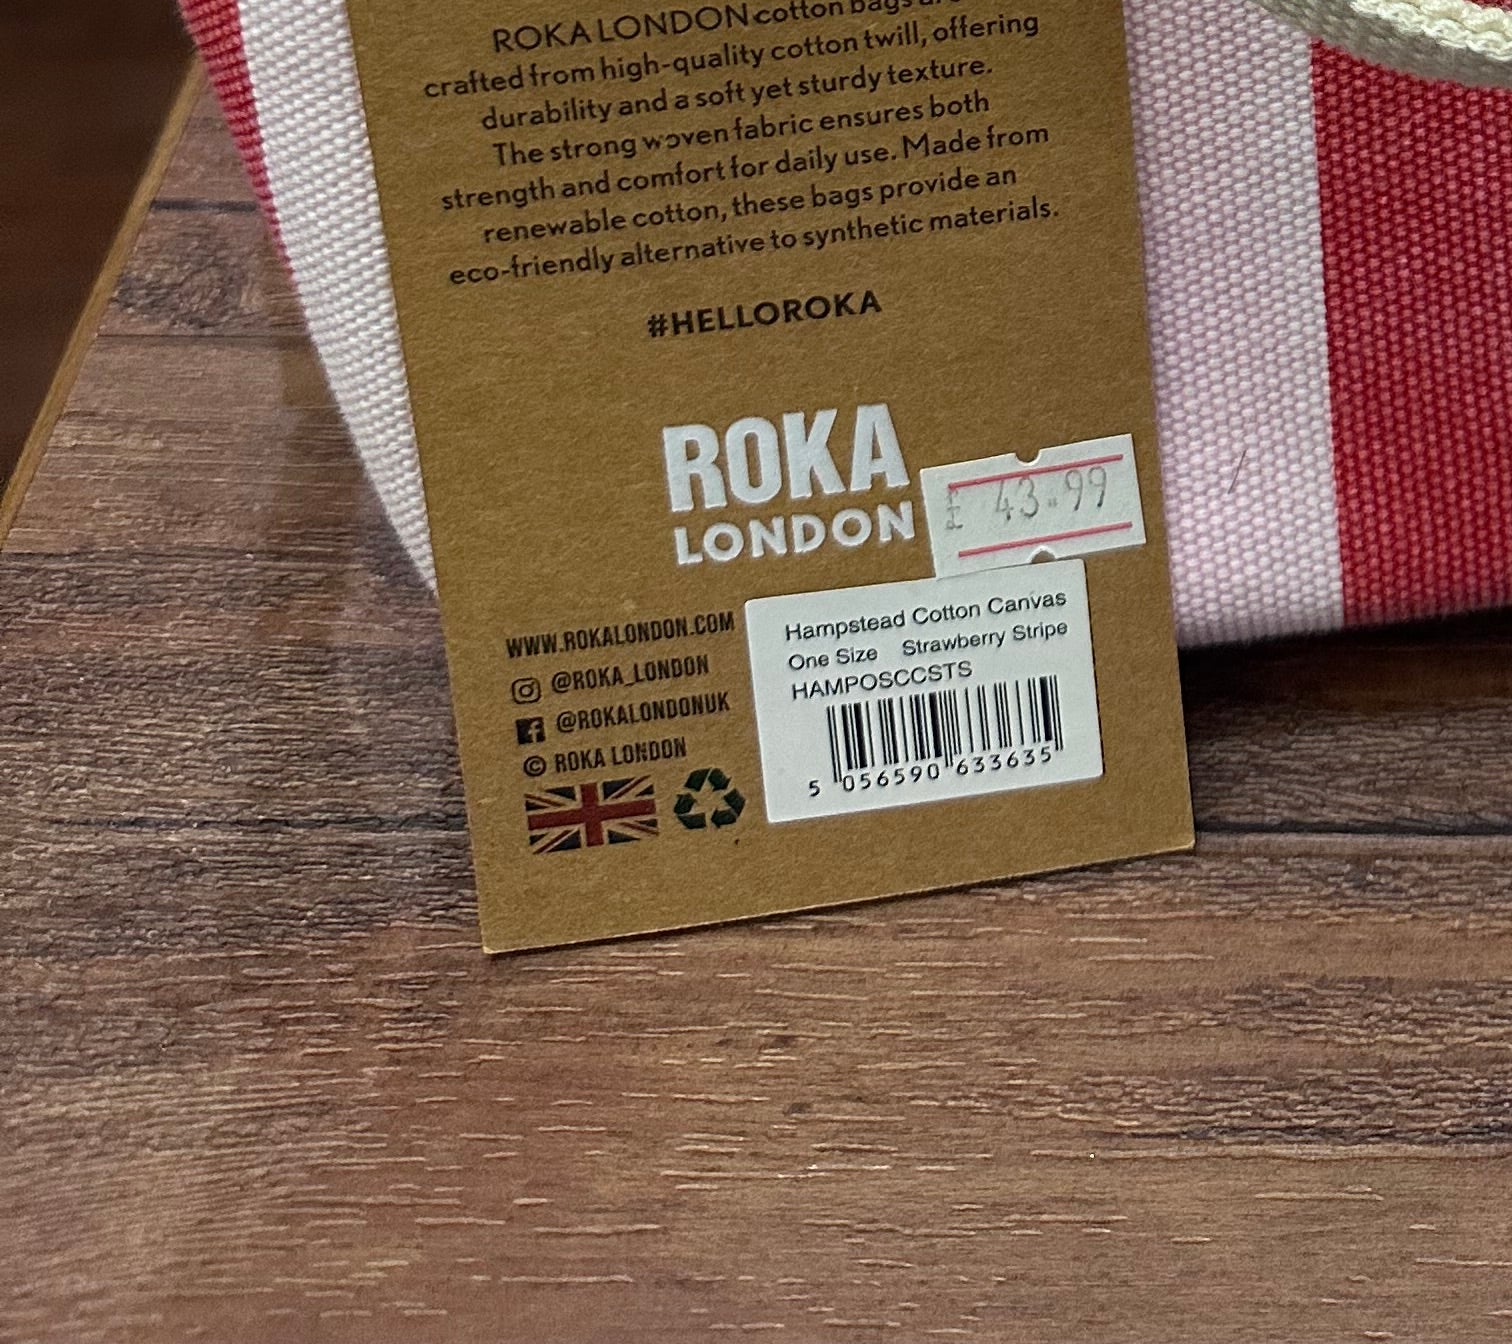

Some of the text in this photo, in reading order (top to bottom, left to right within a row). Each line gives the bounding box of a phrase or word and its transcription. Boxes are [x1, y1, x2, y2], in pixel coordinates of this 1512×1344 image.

[493, 21, 592, 53] ROKA
[599, 3, 748, 42] LONDON
[753, 0, 843, 25] cotton
[424, 14, 1038, 97] crafted from high-quality cotton twill, offering
[482, 59, 992, 129] durability and a soft yet sturdy texture.
[493, 89, 989, 166] The strong woven fabric ensures both
[442, 125, 1048, 210] strength and comfort for daily use. Made from
[484, 167, 1016, 243] renewable cotton, these bags provide an
[450, 196, 1059, 285] eco-friendly alternative to synthetic materials.
[648, 290, 882, 337] #HELLOROKA
[662, 403, 910, 511] ROKA
[674, 501, 915, 565] LONDON
[505, 612, 735, 658] WWW.ROKALONDON.COM
[785, 591, 1066, 641] Hampstead Cotton Canvas
[789, 620, 1068, 671] One Size Strawberry Stripe
[551, 655, 709, 693] @ROKA_LONDON
[792, 661, 973, 700] HAMPOSCCSTS
[557, 692, 730, 733] @ROKALONDONUK
[555, 748, 606, 772] ROKA
[612, 737, 686, 763] LONDON
